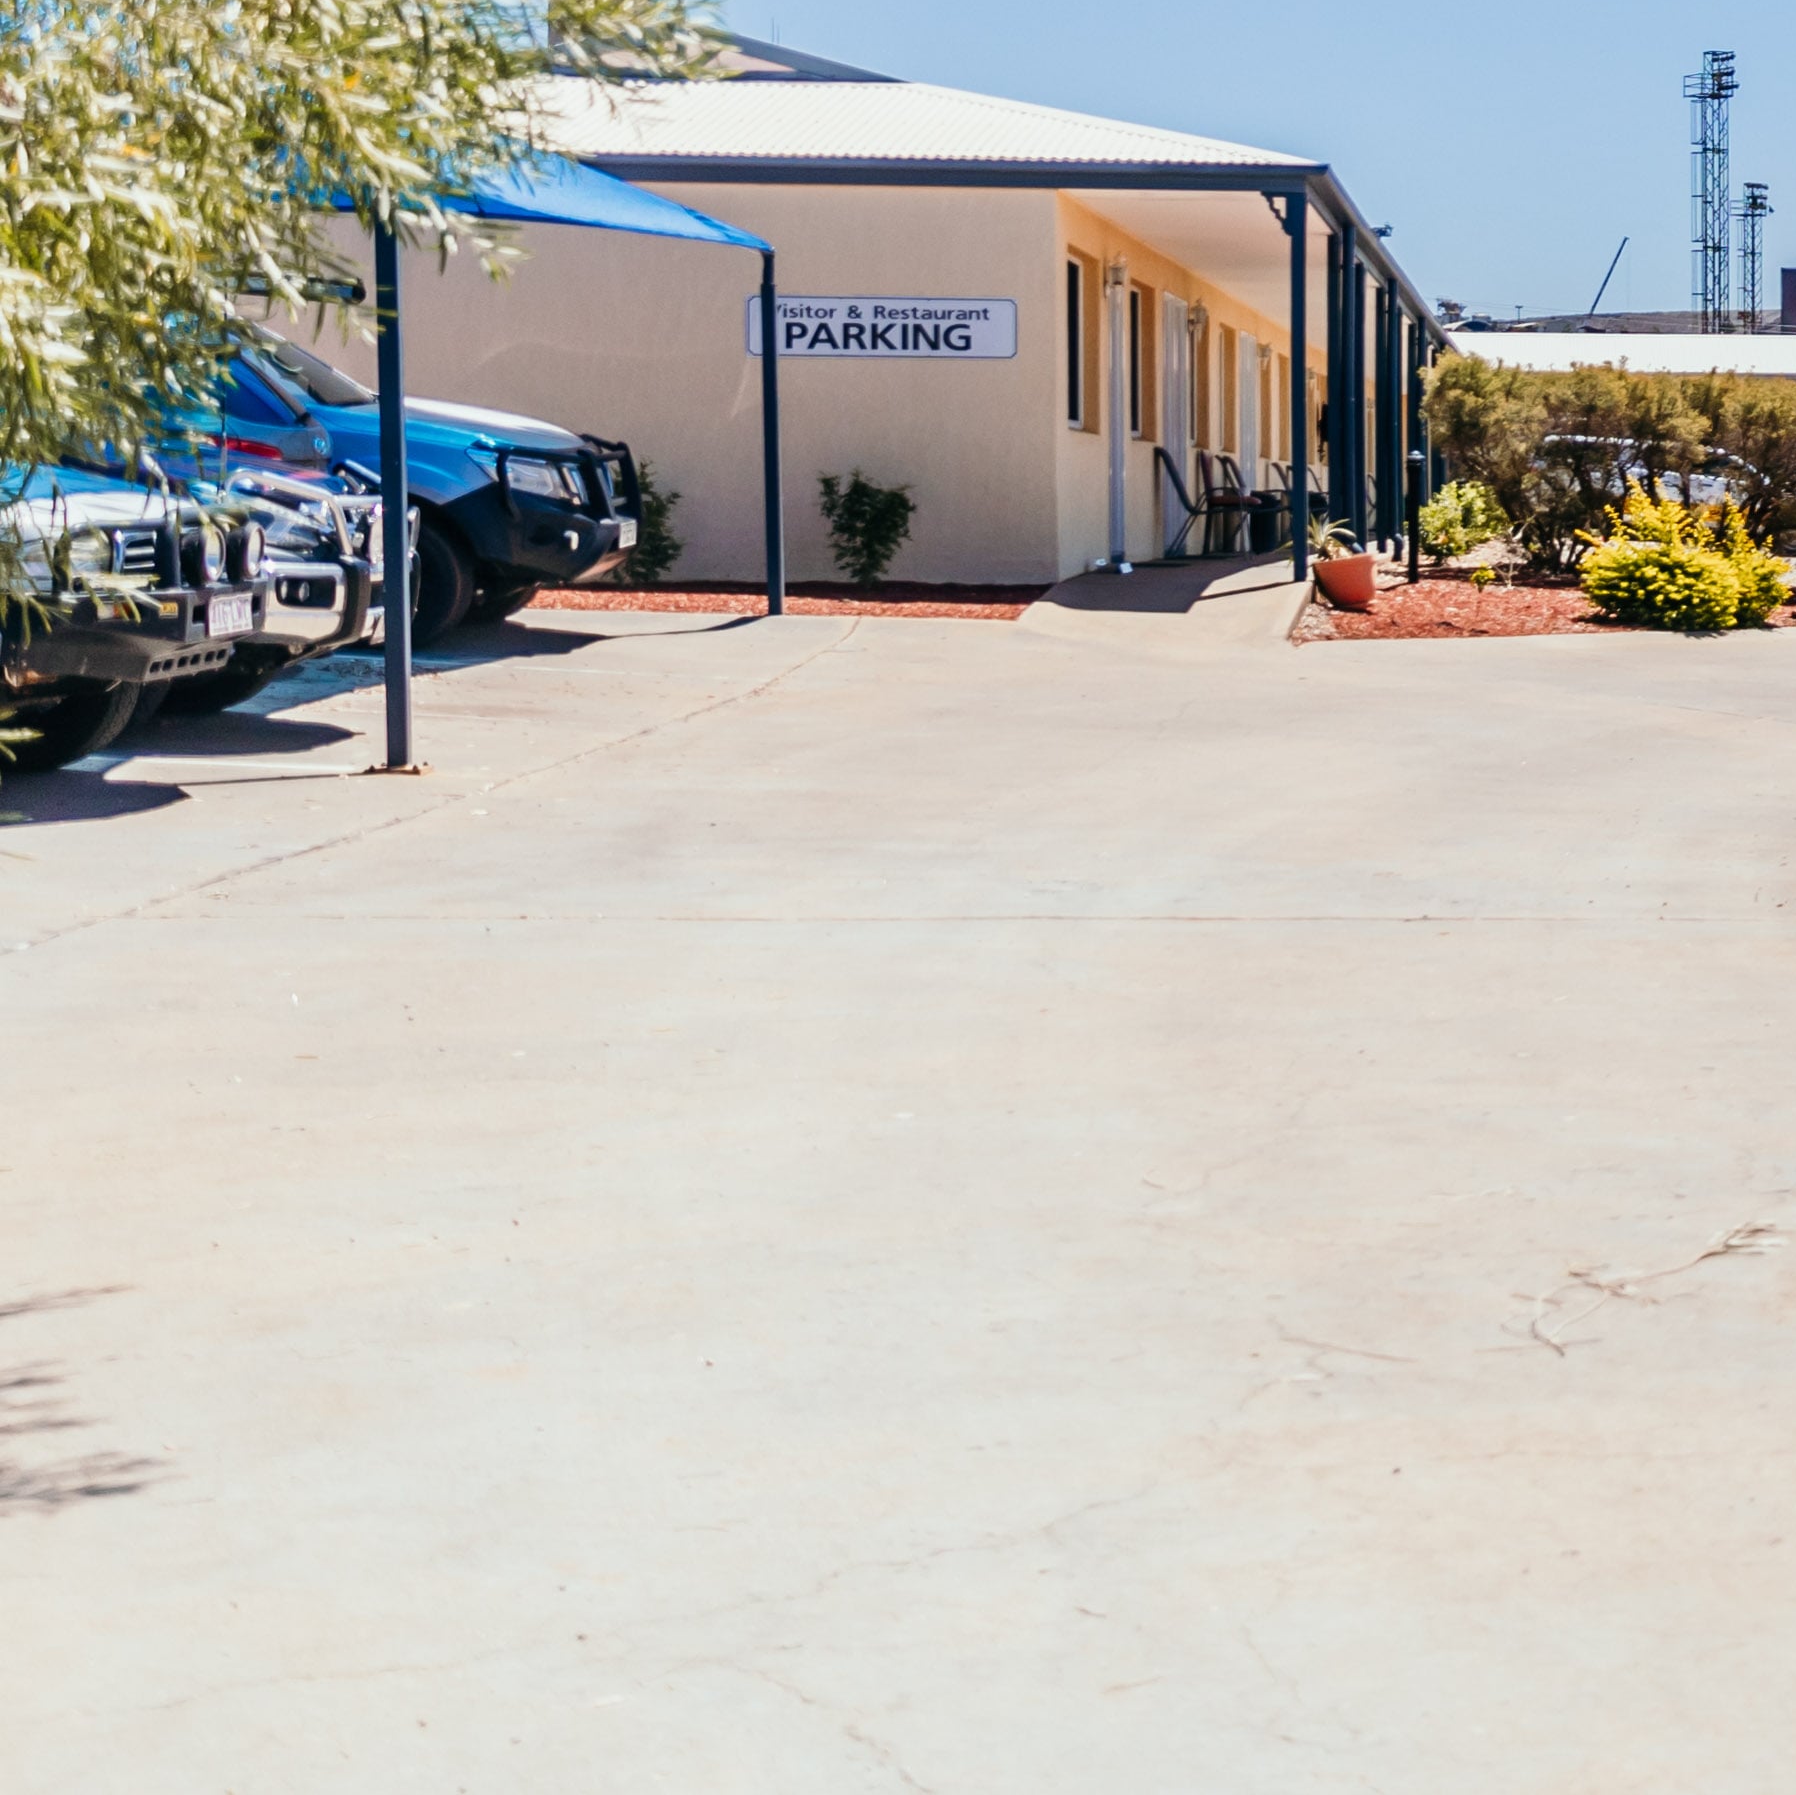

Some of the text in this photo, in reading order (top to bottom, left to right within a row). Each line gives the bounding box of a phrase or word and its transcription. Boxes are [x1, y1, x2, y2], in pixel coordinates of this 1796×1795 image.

[847, 305, 863, 320] &
[873, 305, 990, 321] Restaurant
[785, 321, 972, 352] PARKING
